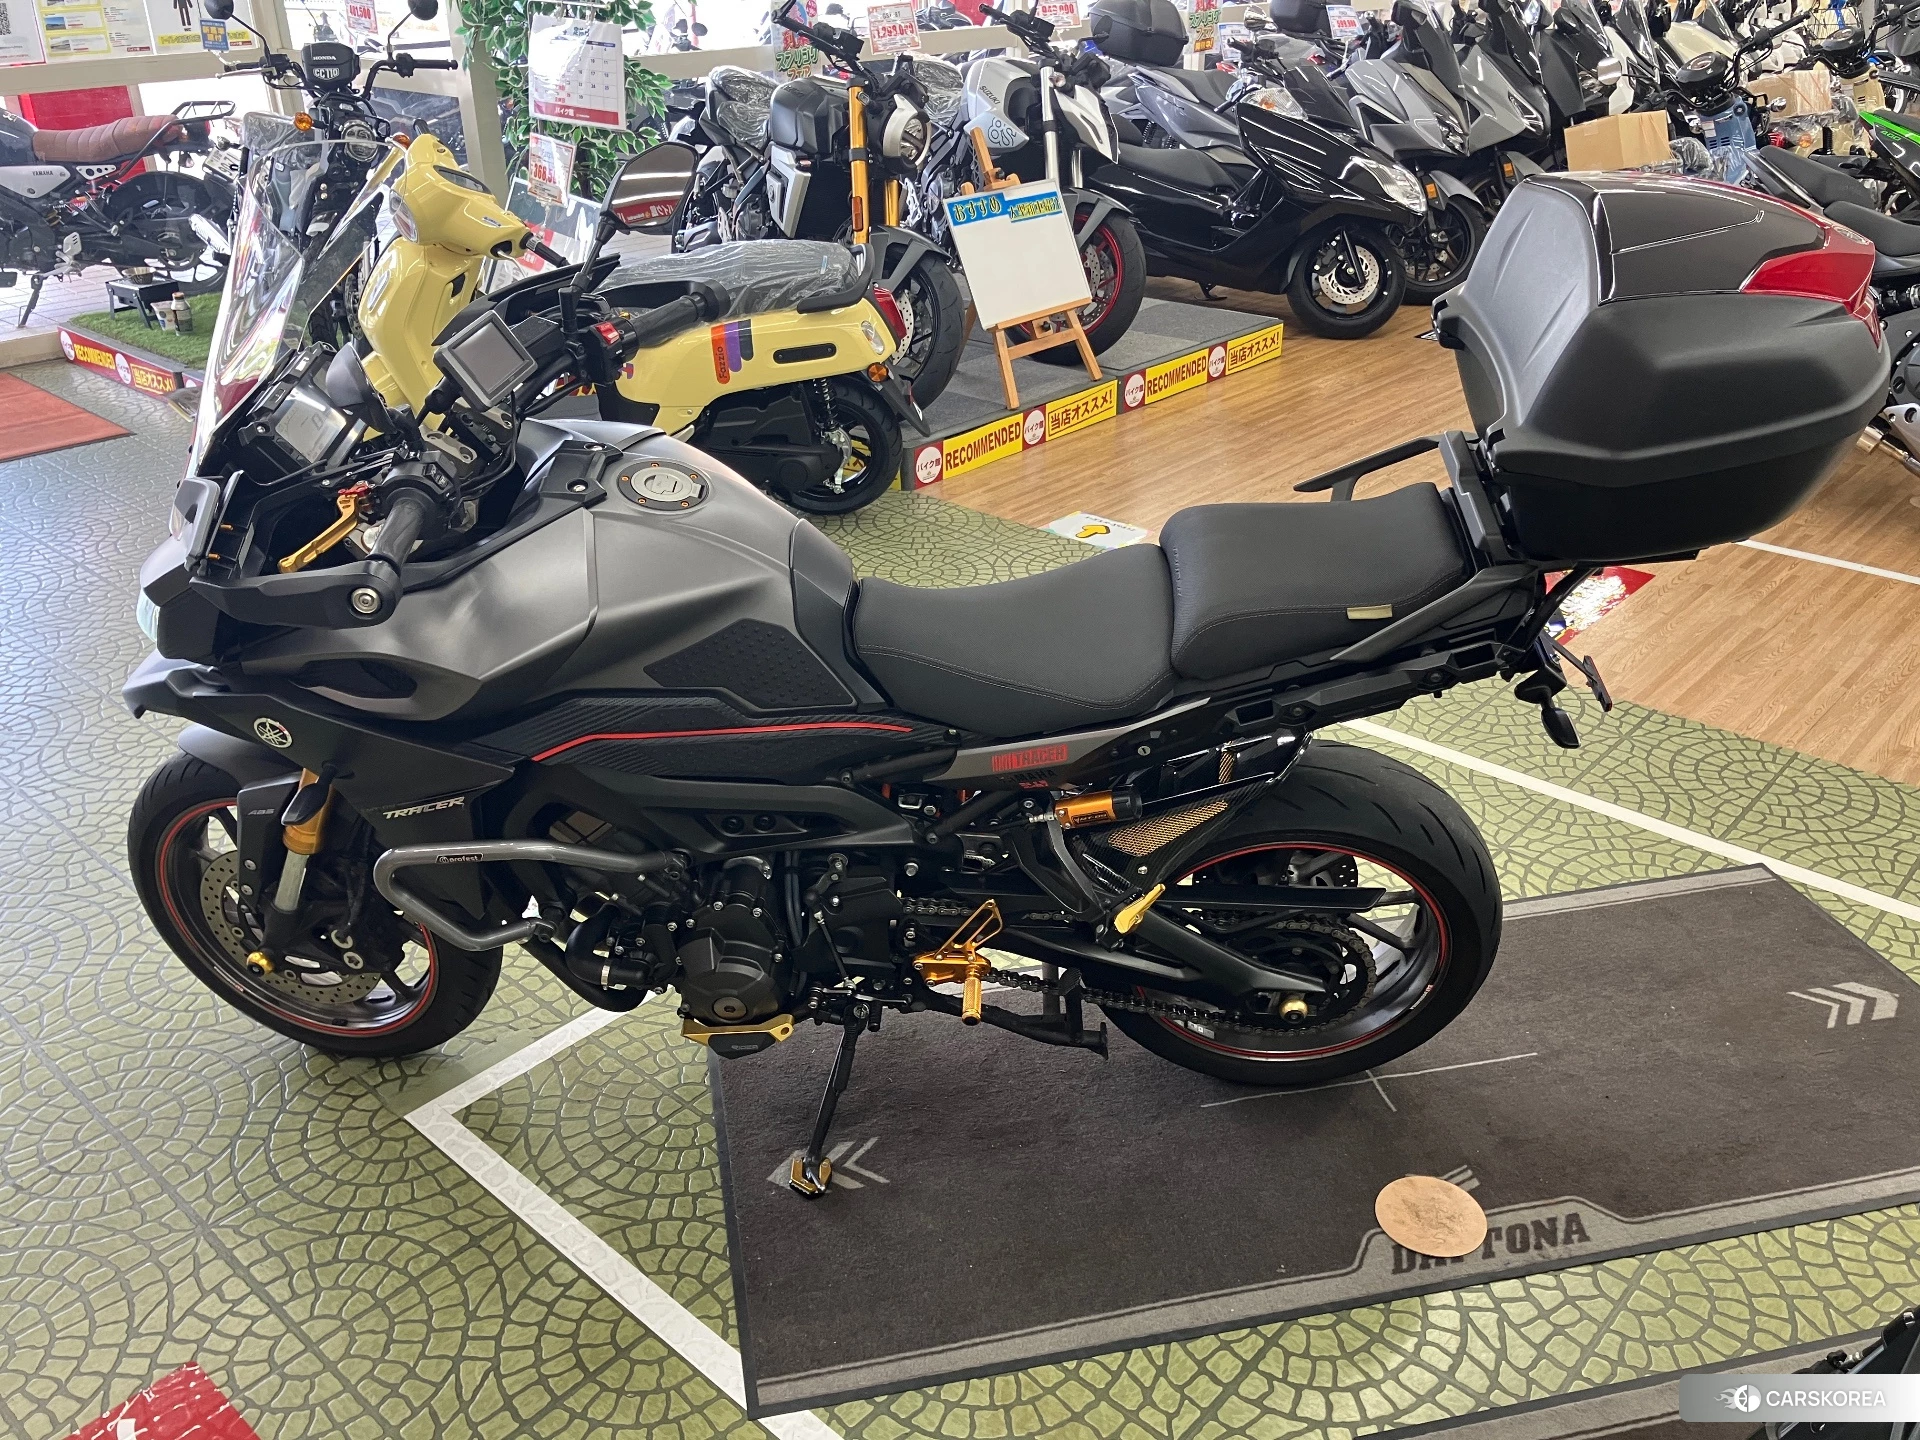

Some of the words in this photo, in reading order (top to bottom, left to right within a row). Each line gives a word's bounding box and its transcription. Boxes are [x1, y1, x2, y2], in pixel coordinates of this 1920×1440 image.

[980, 85, 1001, 105] SUZUKI
[953, 195, 1002, 222] おすすめ
[1230, 331, 1280, 366] 当店オススメ!
[716, 346, 728, 379] Fazzio
[1146, 355, 1207, 397] RECOMMENDED
[1125, 384, 1144, 397] バイク館
[1050, 388, 1113, 431] 当店オススメ!
[1024, 420, 1044, 434] バイク館
[945, 421, 1021, 472] RECOMMENDED
[917, 457, 941, 473] バイク館
[248, 808, 275, 816] ABS
[382, 796, 465, 820] TRACER
[1392, 1211, 1591, 1275] DTONA
